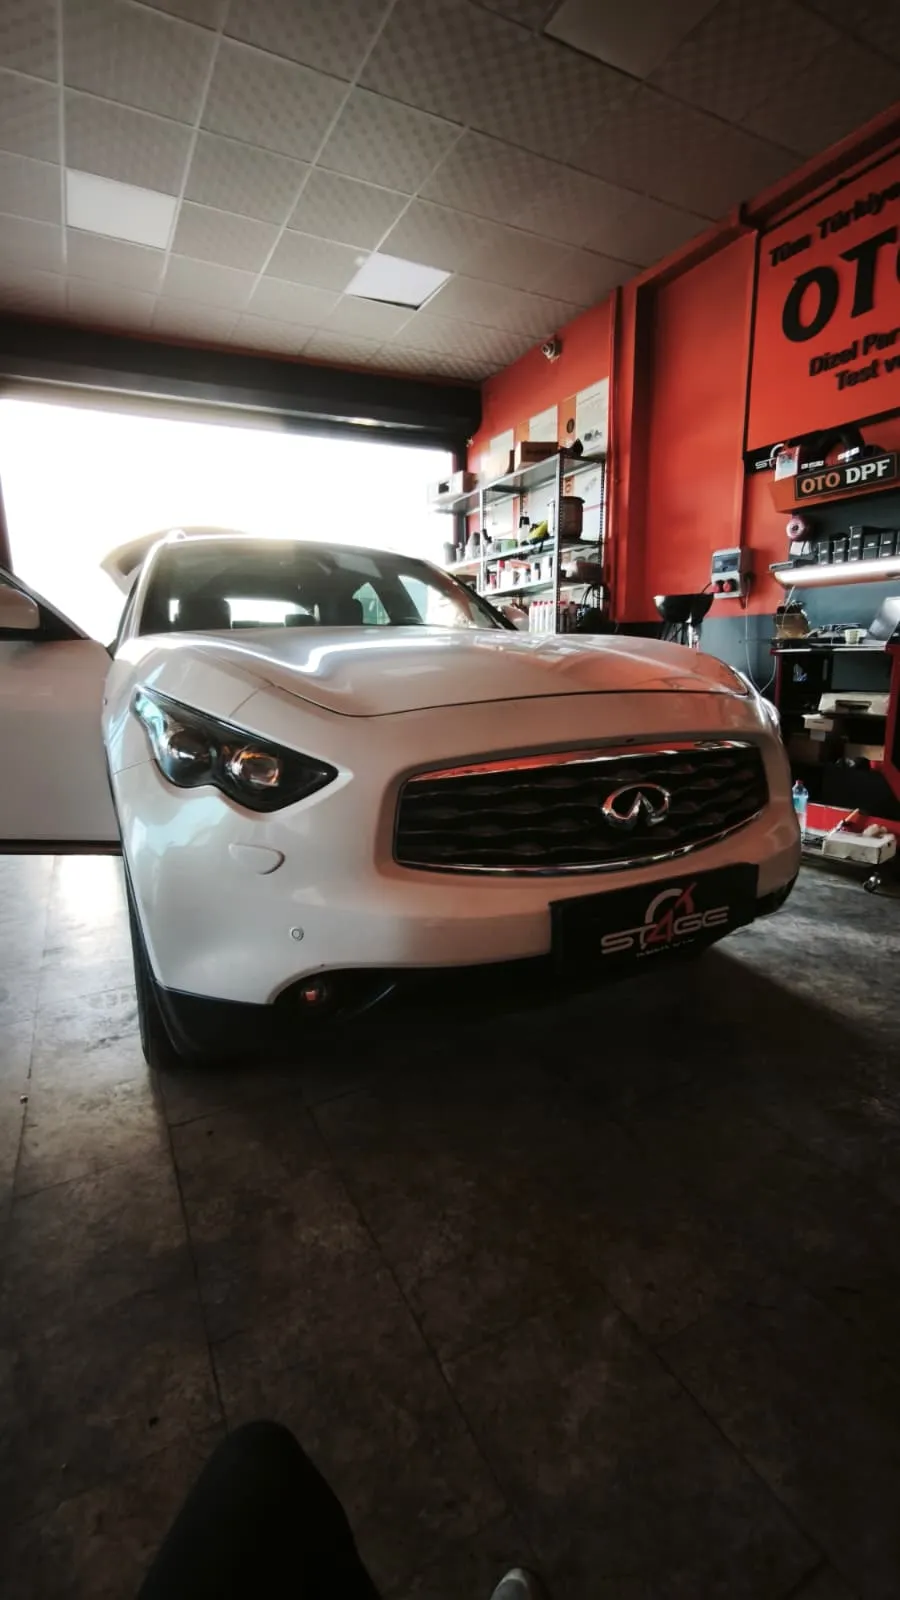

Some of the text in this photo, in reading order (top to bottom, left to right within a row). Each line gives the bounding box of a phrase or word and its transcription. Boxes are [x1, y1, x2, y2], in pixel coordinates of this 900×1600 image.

[782, 225, 900, 343] OT
[834, 358, 880, 392] Test
[801, 471, 841, 494] OTO
[845, 459, 890, 485] DPF
